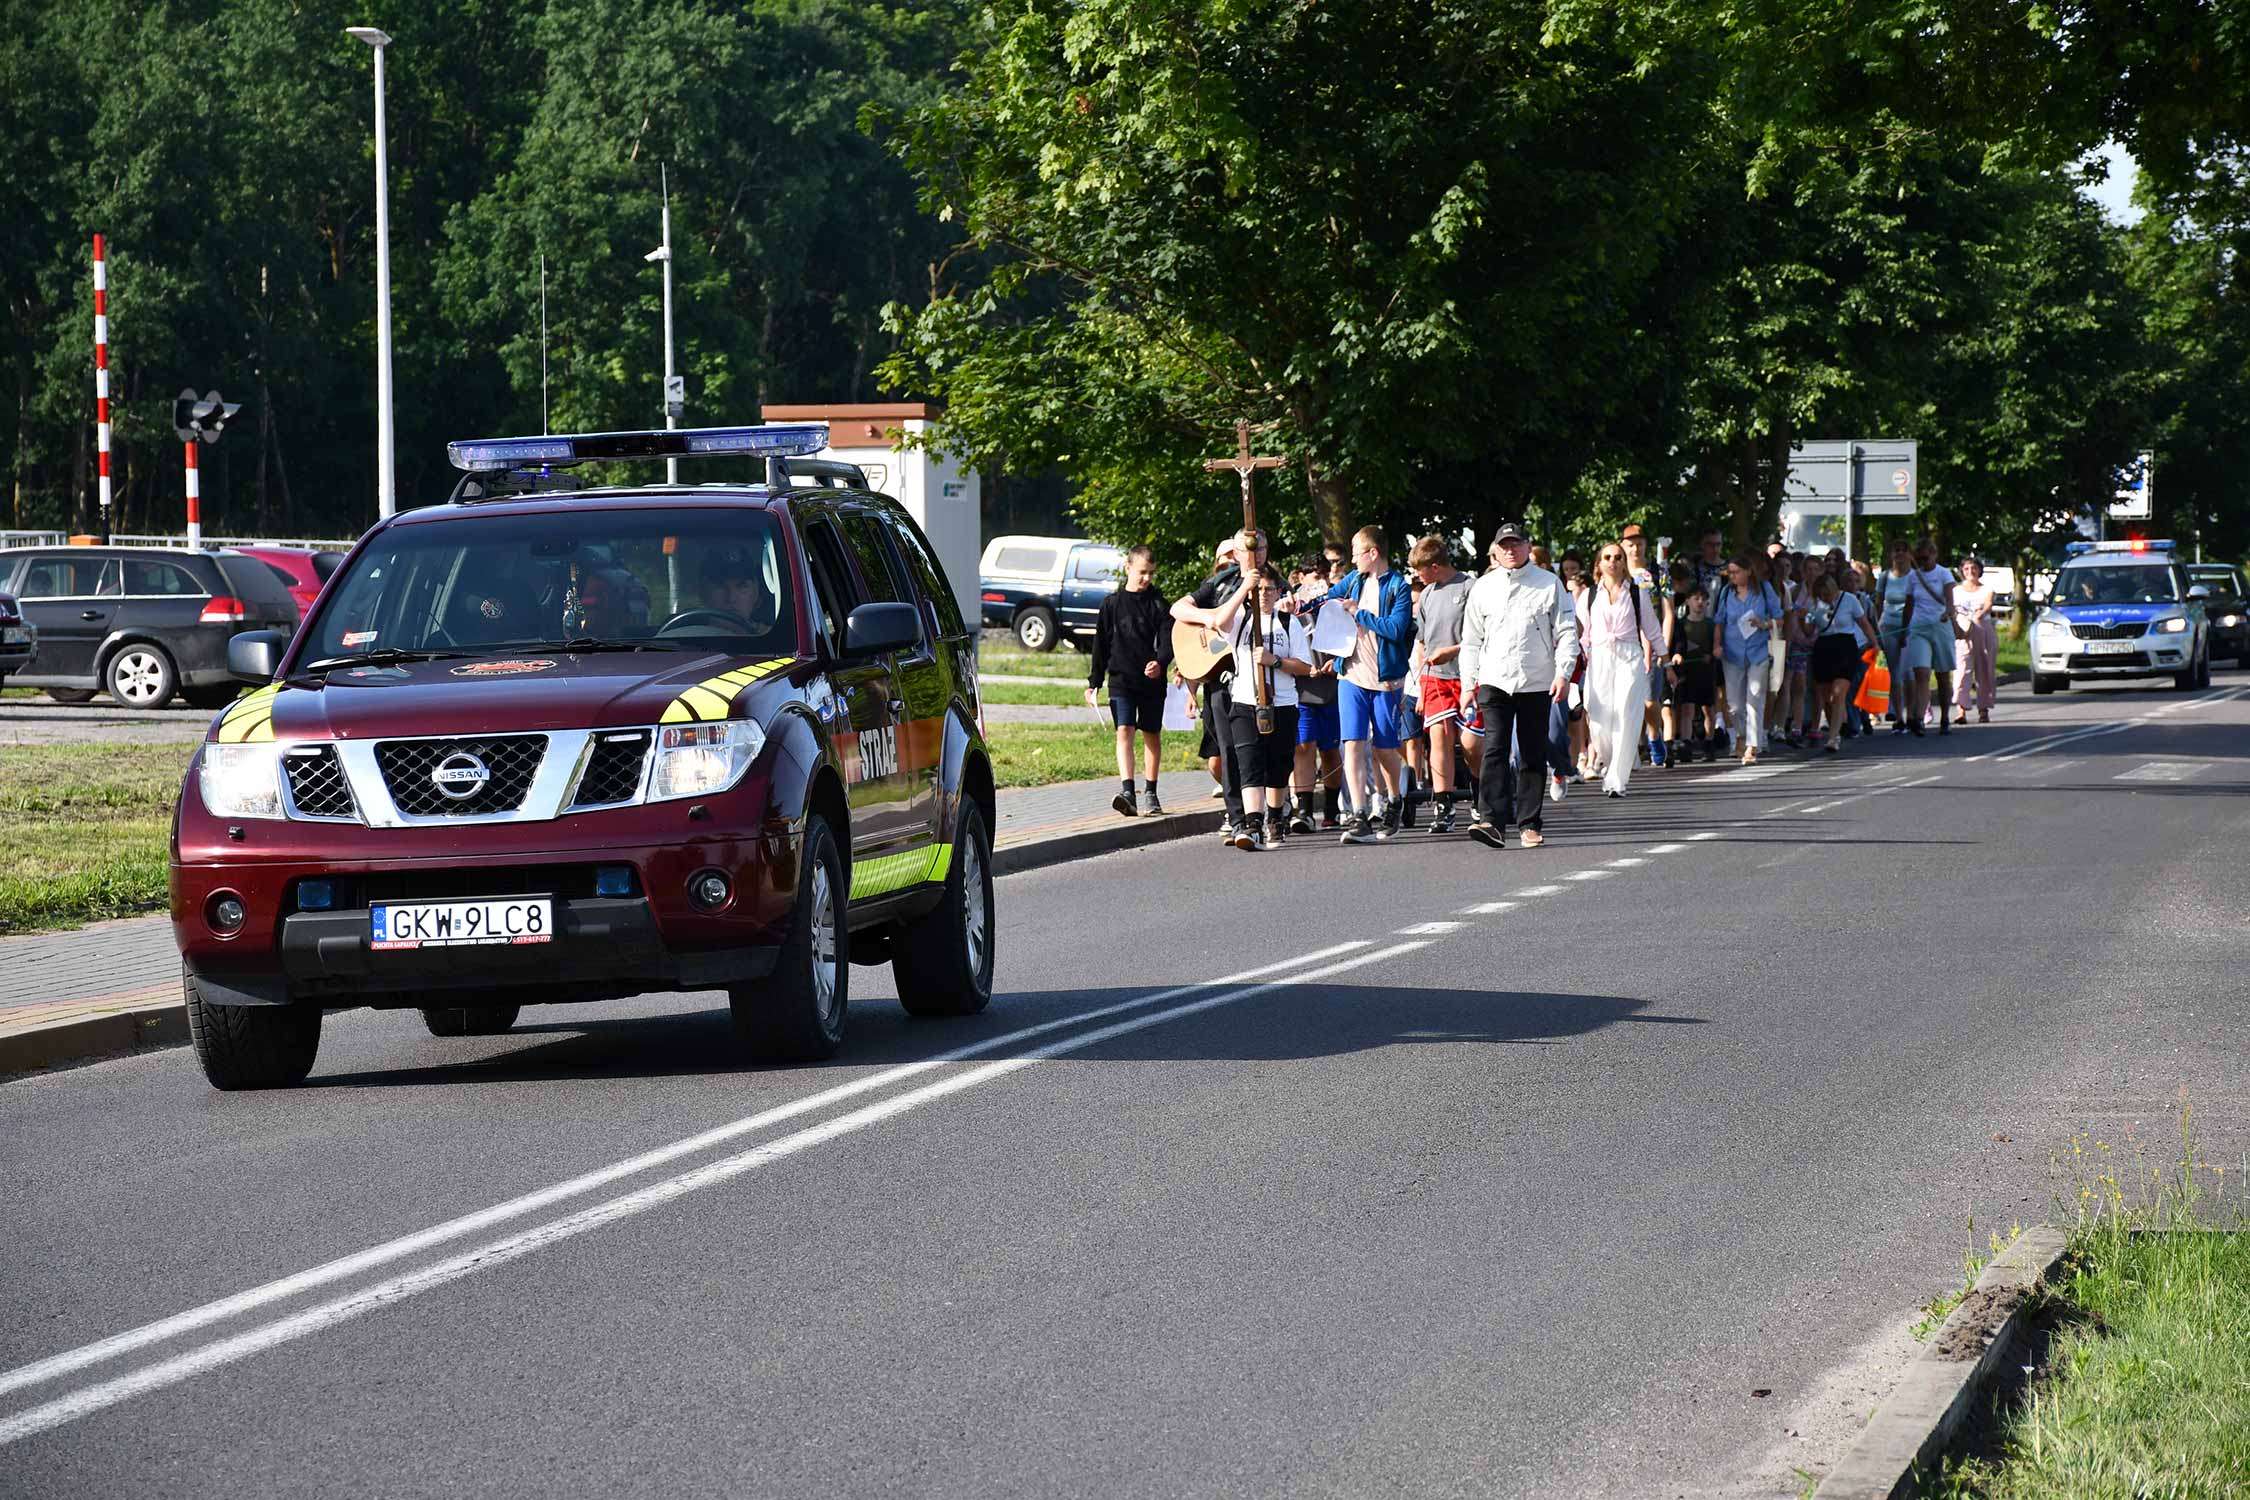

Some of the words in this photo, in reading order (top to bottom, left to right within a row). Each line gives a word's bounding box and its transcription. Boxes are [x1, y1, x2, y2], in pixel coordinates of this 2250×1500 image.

[439, 771, 483, 780] NISSAN
[393, 908, 452, 939] GKW
[465, 904, 543, 937] 9LC8
[373, 929, 386, 938] PL
